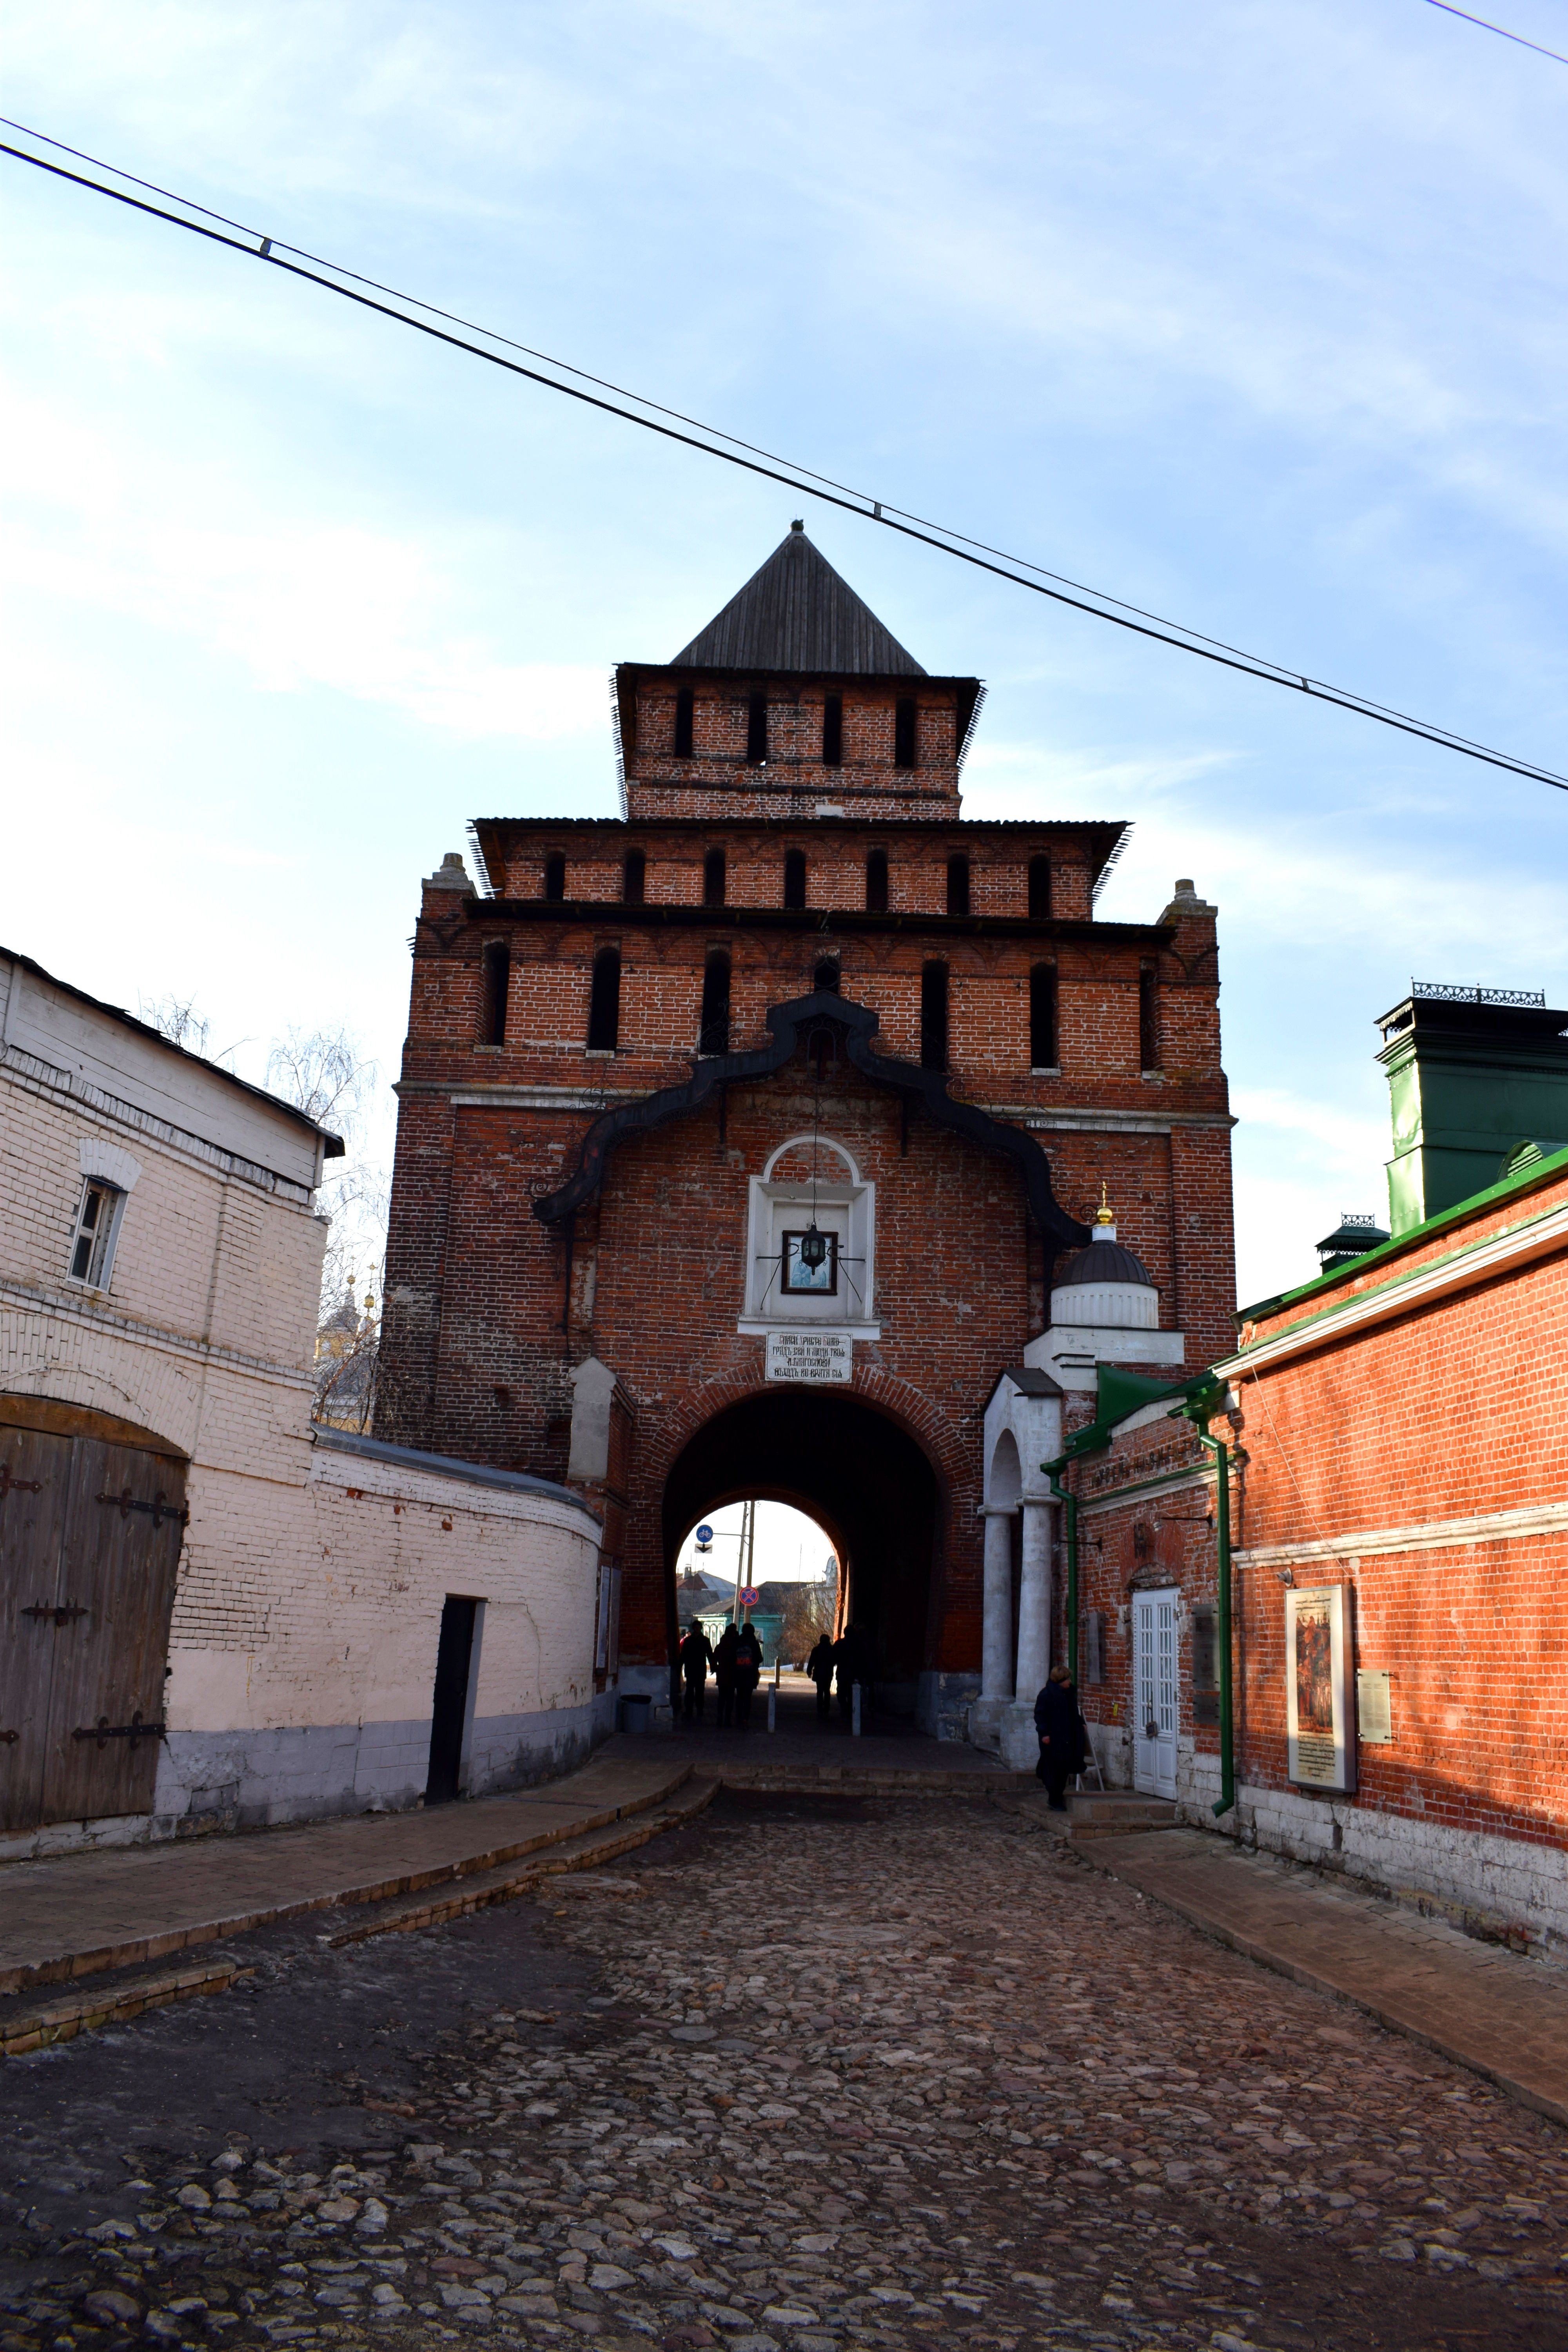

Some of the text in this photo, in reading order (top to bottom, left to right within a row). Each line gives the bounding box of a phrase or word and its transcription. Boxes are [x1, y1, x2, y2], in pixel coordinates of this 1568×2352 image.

[807, 1347, 810, 1356] И
[812, 1347, 828, 1358] ЛЮДИ
[801, 1368, 808, 1377] ВО
